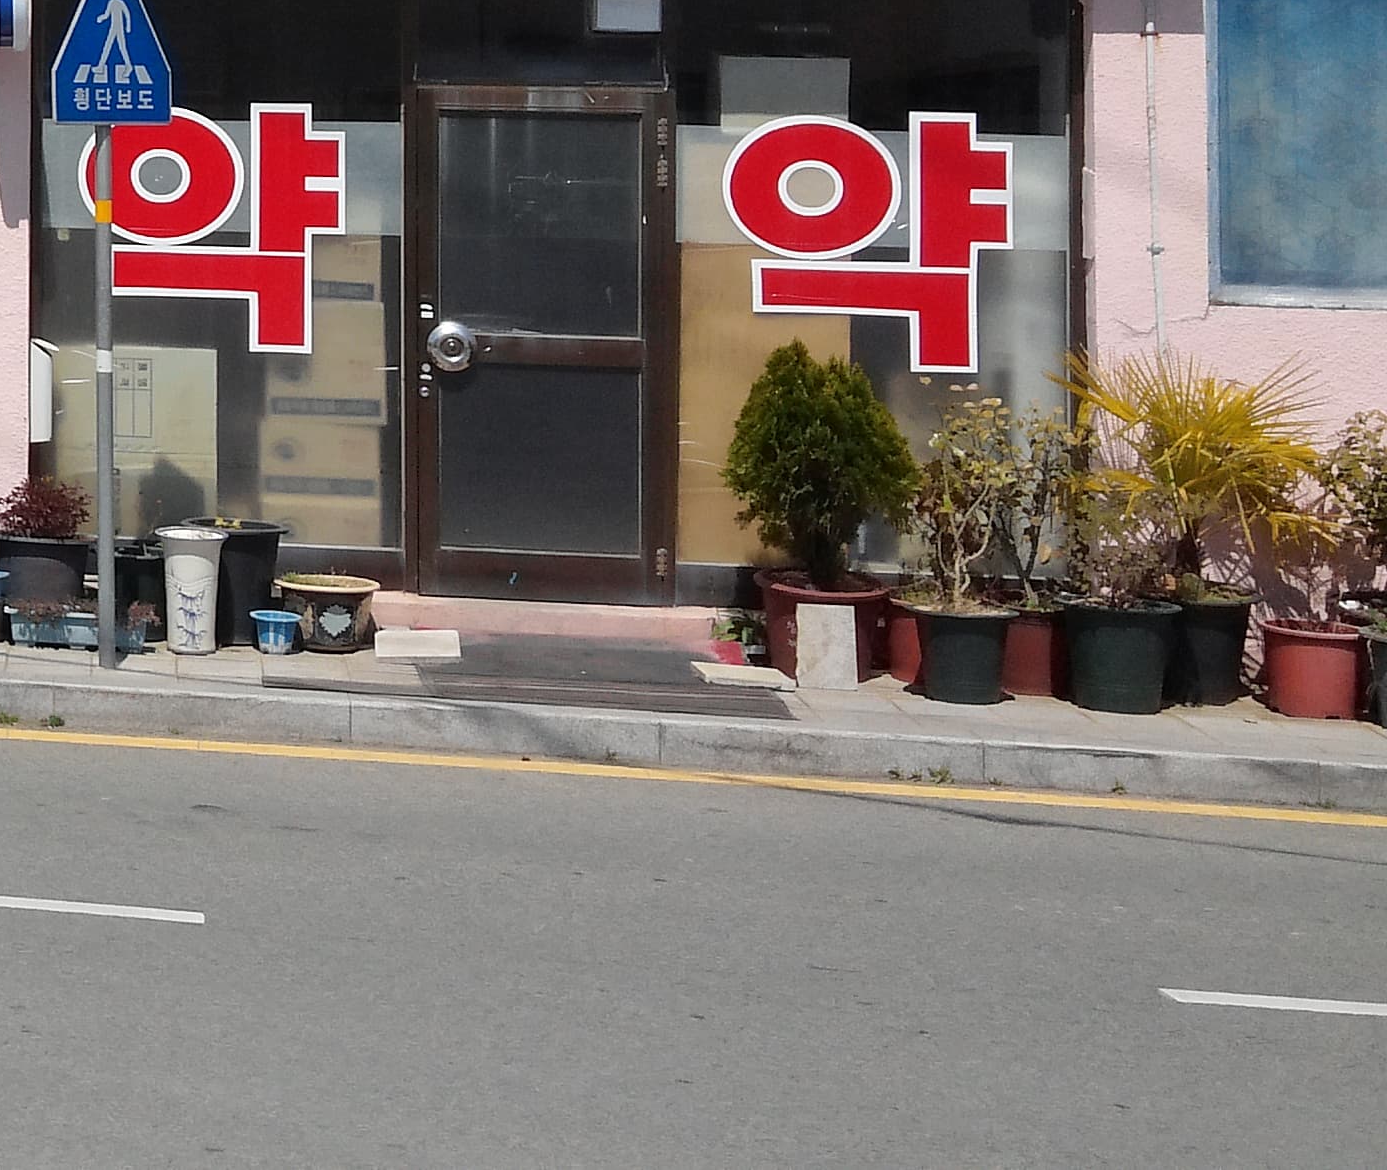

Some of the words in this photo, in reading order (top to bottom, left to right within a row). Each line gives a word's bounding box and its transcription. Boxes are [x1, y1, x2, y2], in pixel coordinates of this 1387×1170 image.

[72, 87, 155, 111] 횡단보도
[78, 103, 346, 354] 약
[722, 111, 1014, 373] 약
